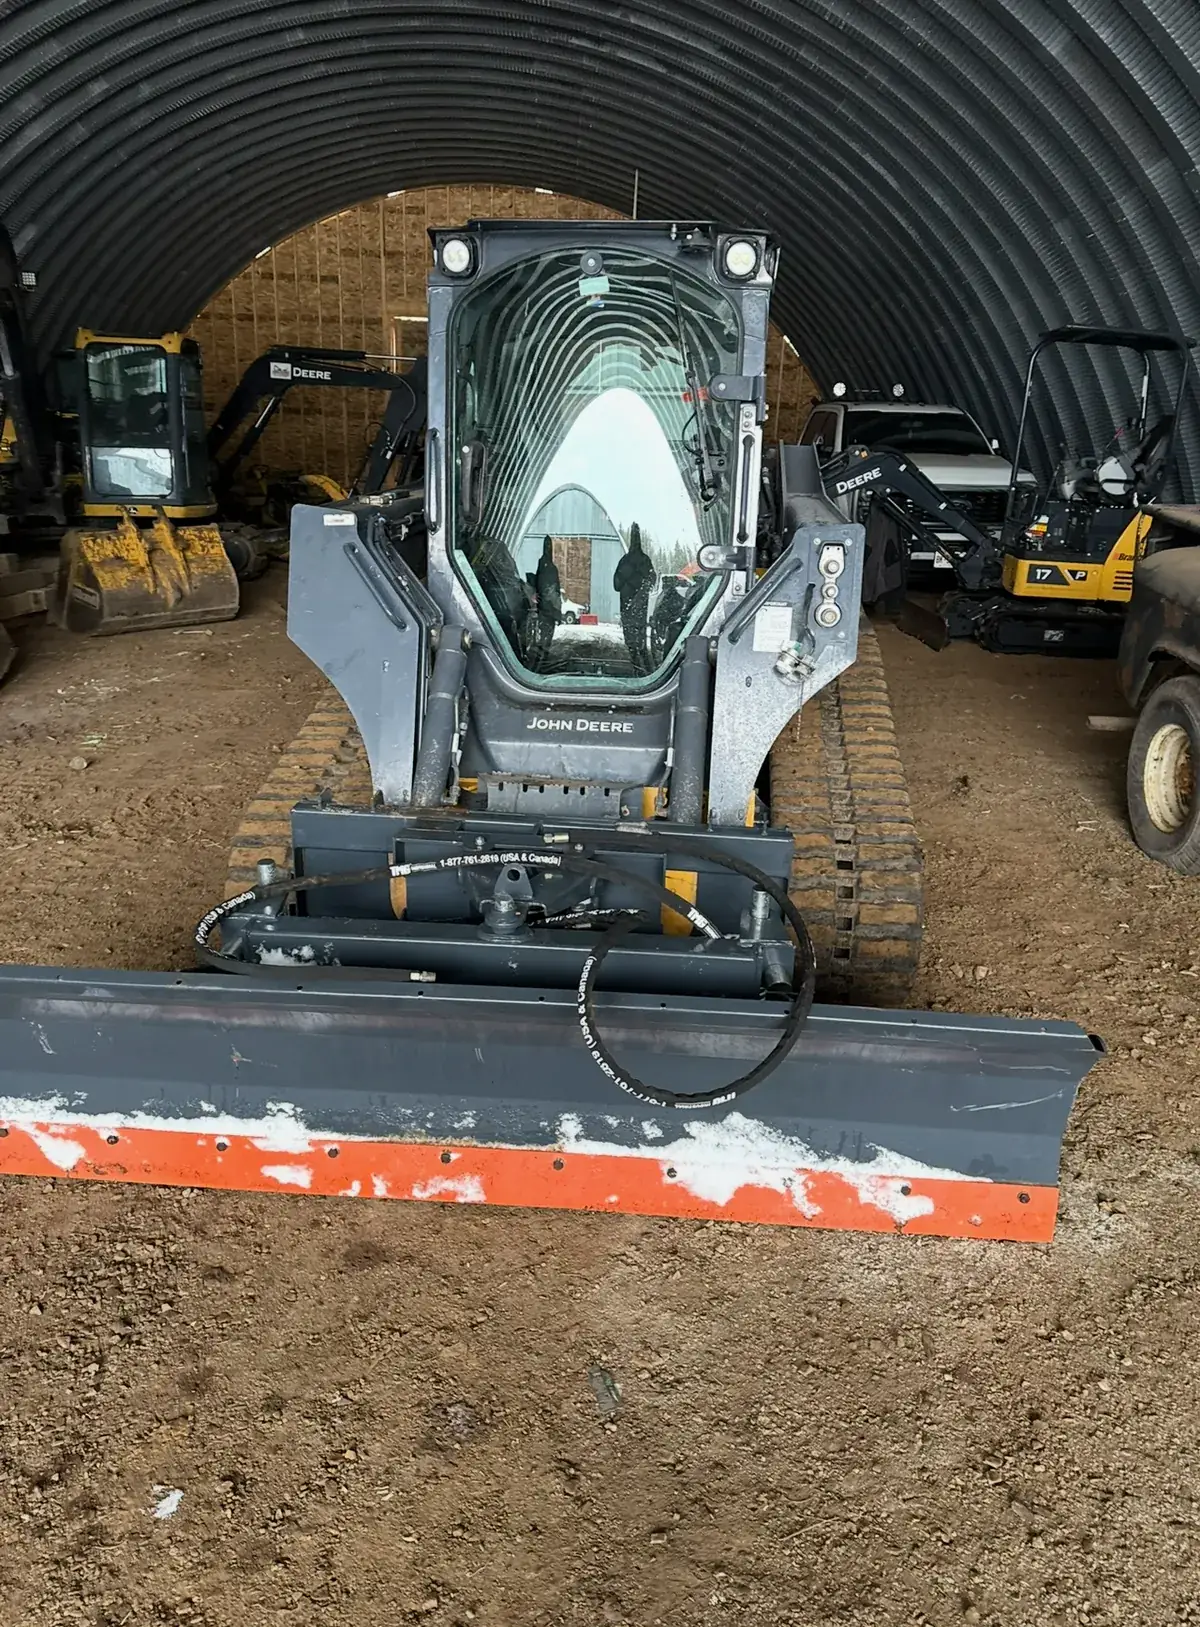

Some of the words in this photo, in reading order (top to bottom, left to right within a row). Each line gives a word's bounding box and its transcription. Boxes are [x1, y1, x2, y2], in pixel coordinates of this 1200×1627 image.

[293, 366, 332, 380] DEERE
[835, 467, 882, 494] DEERE
[1035, 568, 1053, 580] 17
[1075, 571, 1086, 580] P
[526, 716, 573, 731] JOHN
[576, 718, 634, 733] DEERE
[439, 852, 499, 868] 1-877-761-2819
[500, 852, 521, 864] (USA
[521, 852, 528, 861] &
[528, 853, 563, 866] Canada)
[214, 907, 225, 915] &
[221, 891, 256, 910] Canada)
